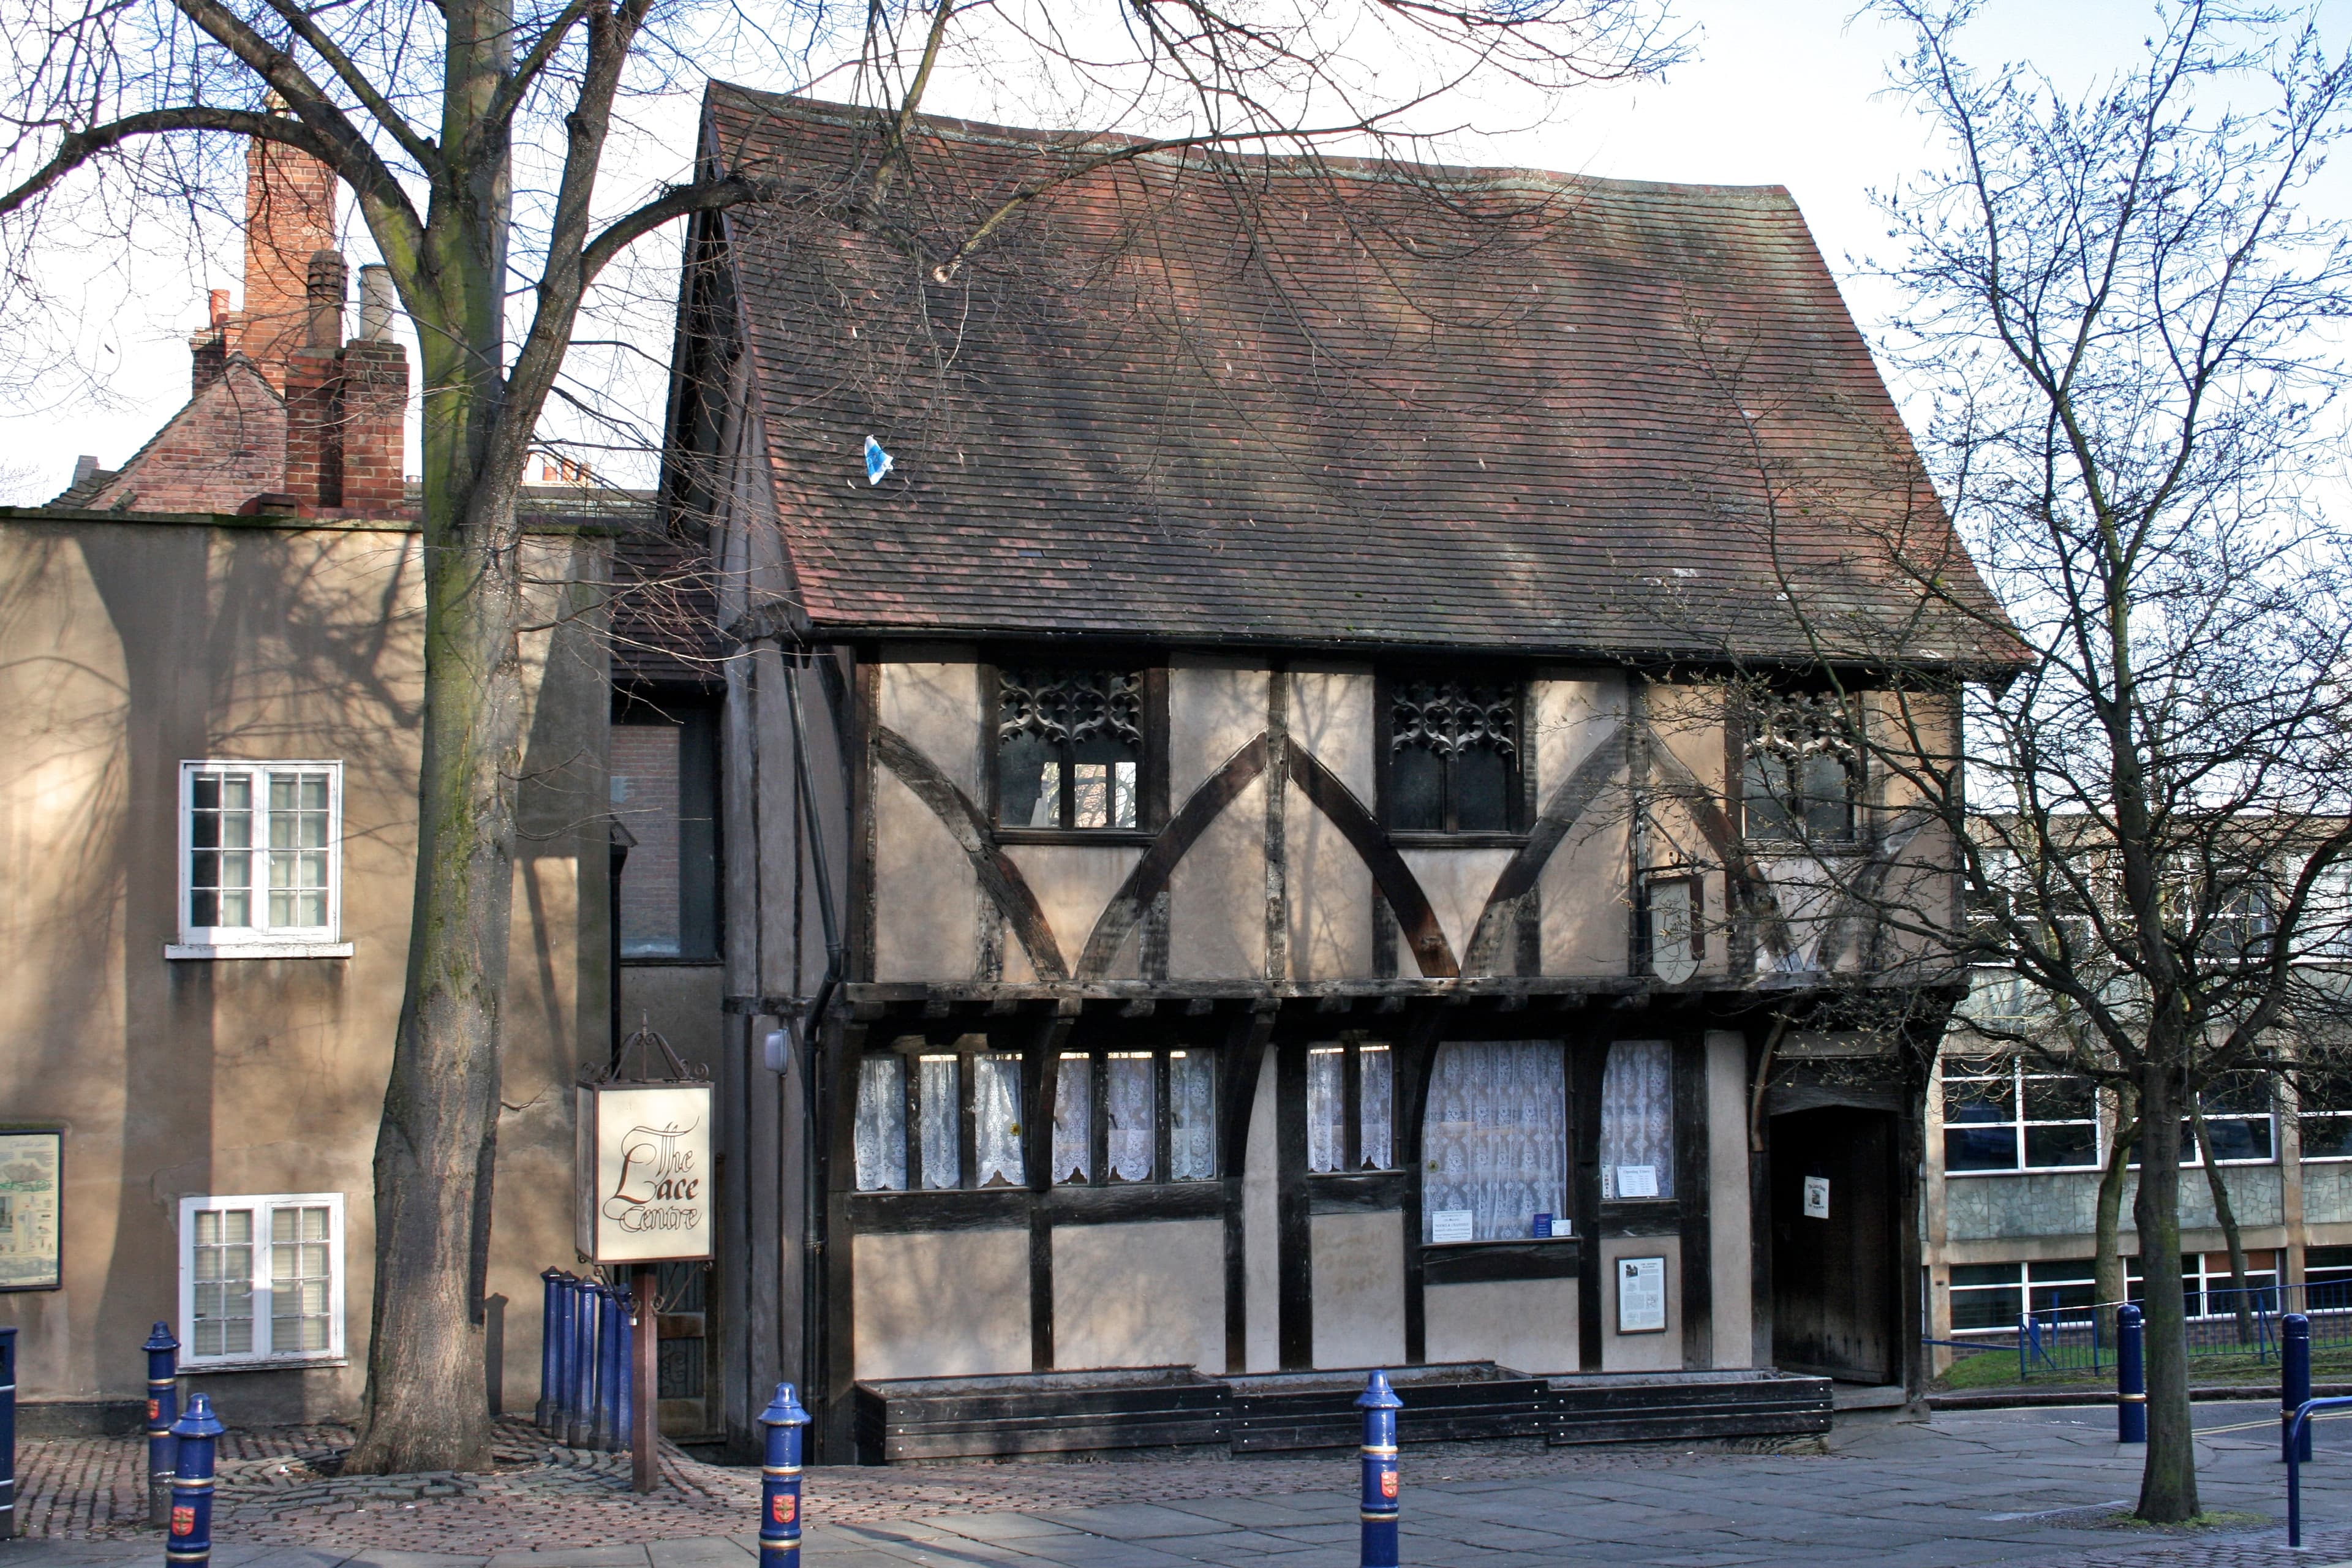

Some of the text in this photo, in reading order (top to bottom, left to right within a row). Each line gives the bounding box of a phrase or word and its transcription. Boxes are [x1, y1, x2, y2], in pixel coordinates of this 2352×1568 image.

[613, 1143, 699, 1205] Lace
[620, 1115, 700, 1180] The
[619, 1205, 702, 1234] Centre
